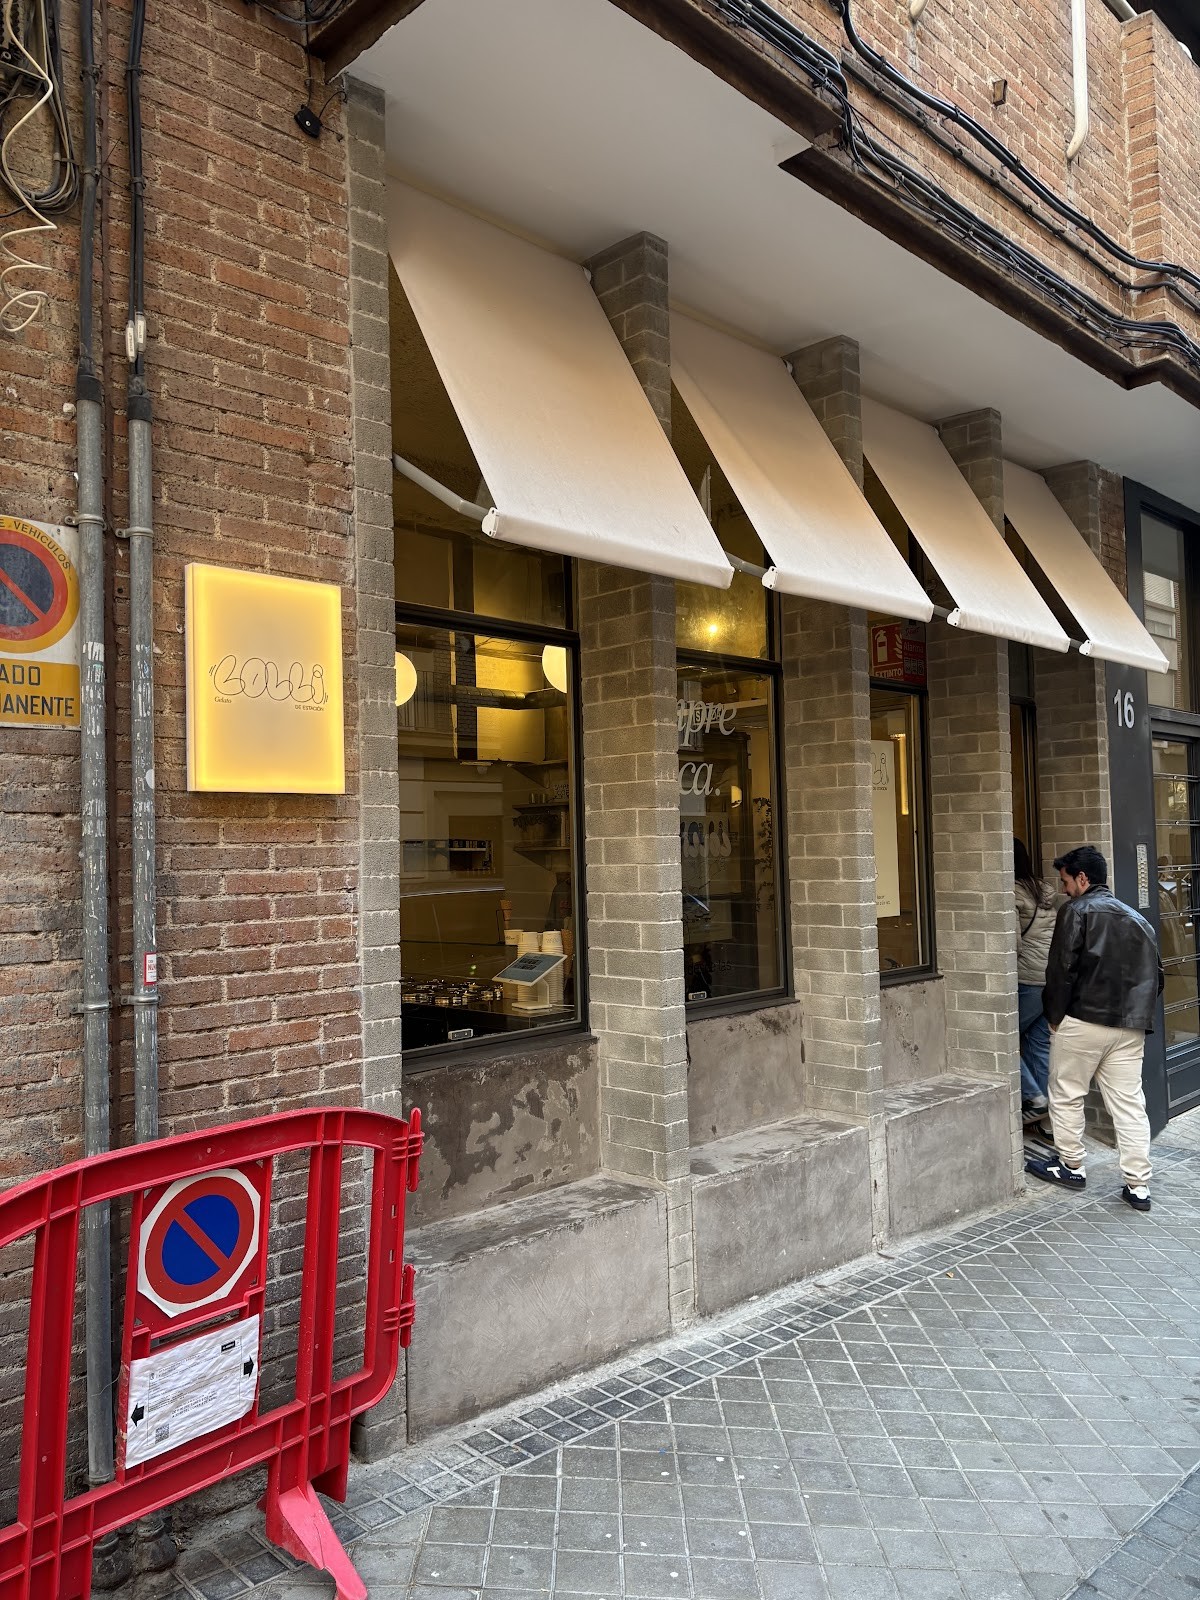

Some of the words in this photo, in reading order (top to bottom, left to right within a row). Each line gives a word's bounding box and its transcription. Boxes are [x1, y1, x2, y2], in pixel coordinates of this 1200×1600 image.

[14, 520, 71, 569] VEHICULOS
[0, 664, 41, 685] ADO
[0, 693, 75, 717] ANENTE
[1113, 688, 1135, 729] 16
